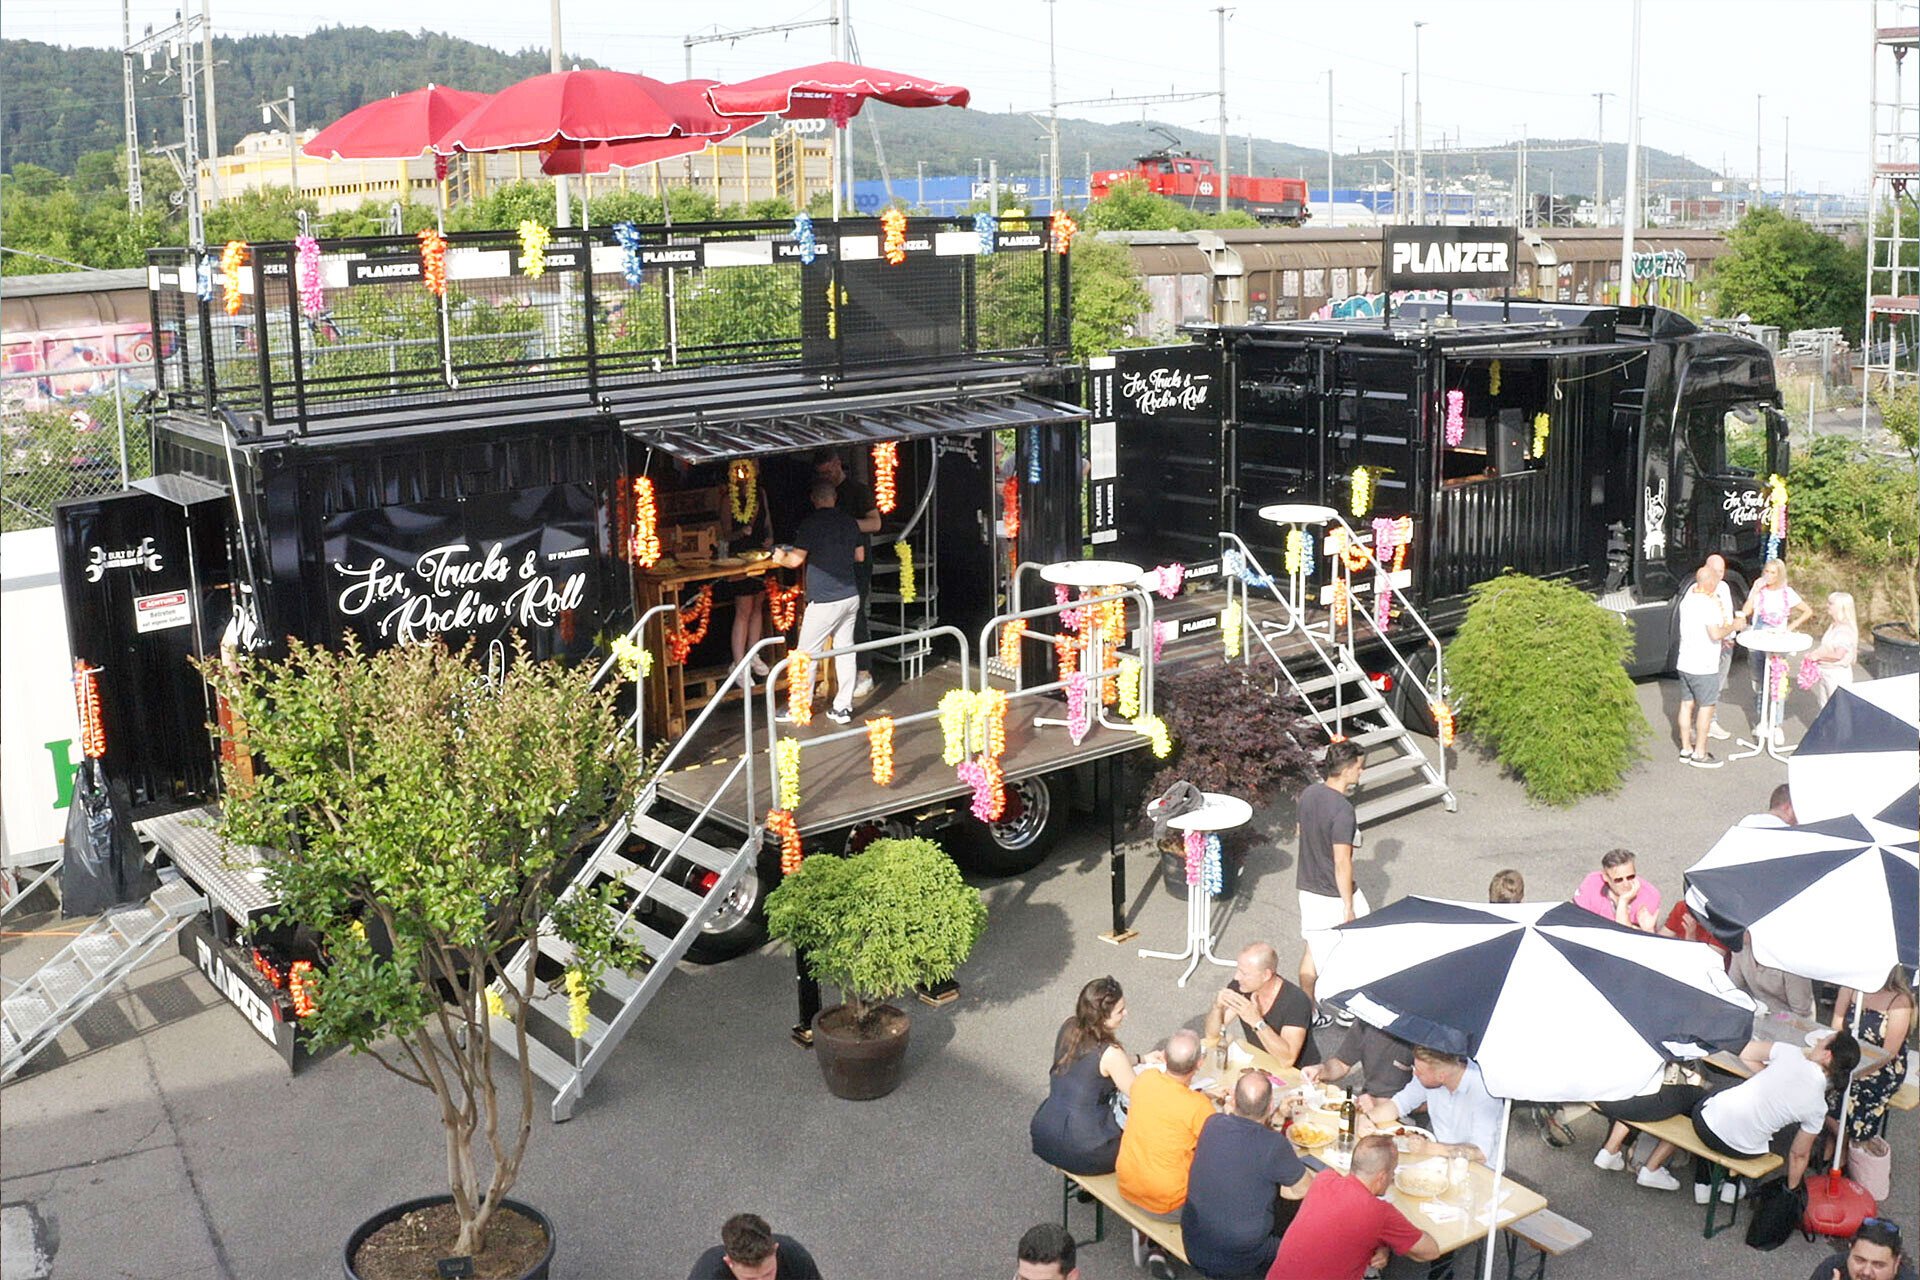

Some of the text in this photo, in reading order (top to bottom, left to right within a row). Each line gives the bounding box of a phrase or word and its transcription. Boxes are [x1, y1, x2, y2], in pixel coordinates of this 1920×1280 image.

[998, 235, 1040, 247] PLANZER
[643, 250, 696, 263] PLANZER
[1393, 242, 1509, 274] PLANZER
[356, 263, 421, 279] PLANZER
[1177, 386, 1208, 411] Roll
[557, 548, 590, 560] PLANZER
[416, 542, 511, 597] Trucks
[519, 550, 536, 579] &
[1184, 564, 1218, 580] PLANZER
[380, 573, 586, 648] Rock'n Roll
[1183, 617, 1217, 633] PLANZER
[196, 935, 277, 1046] PLANZER
